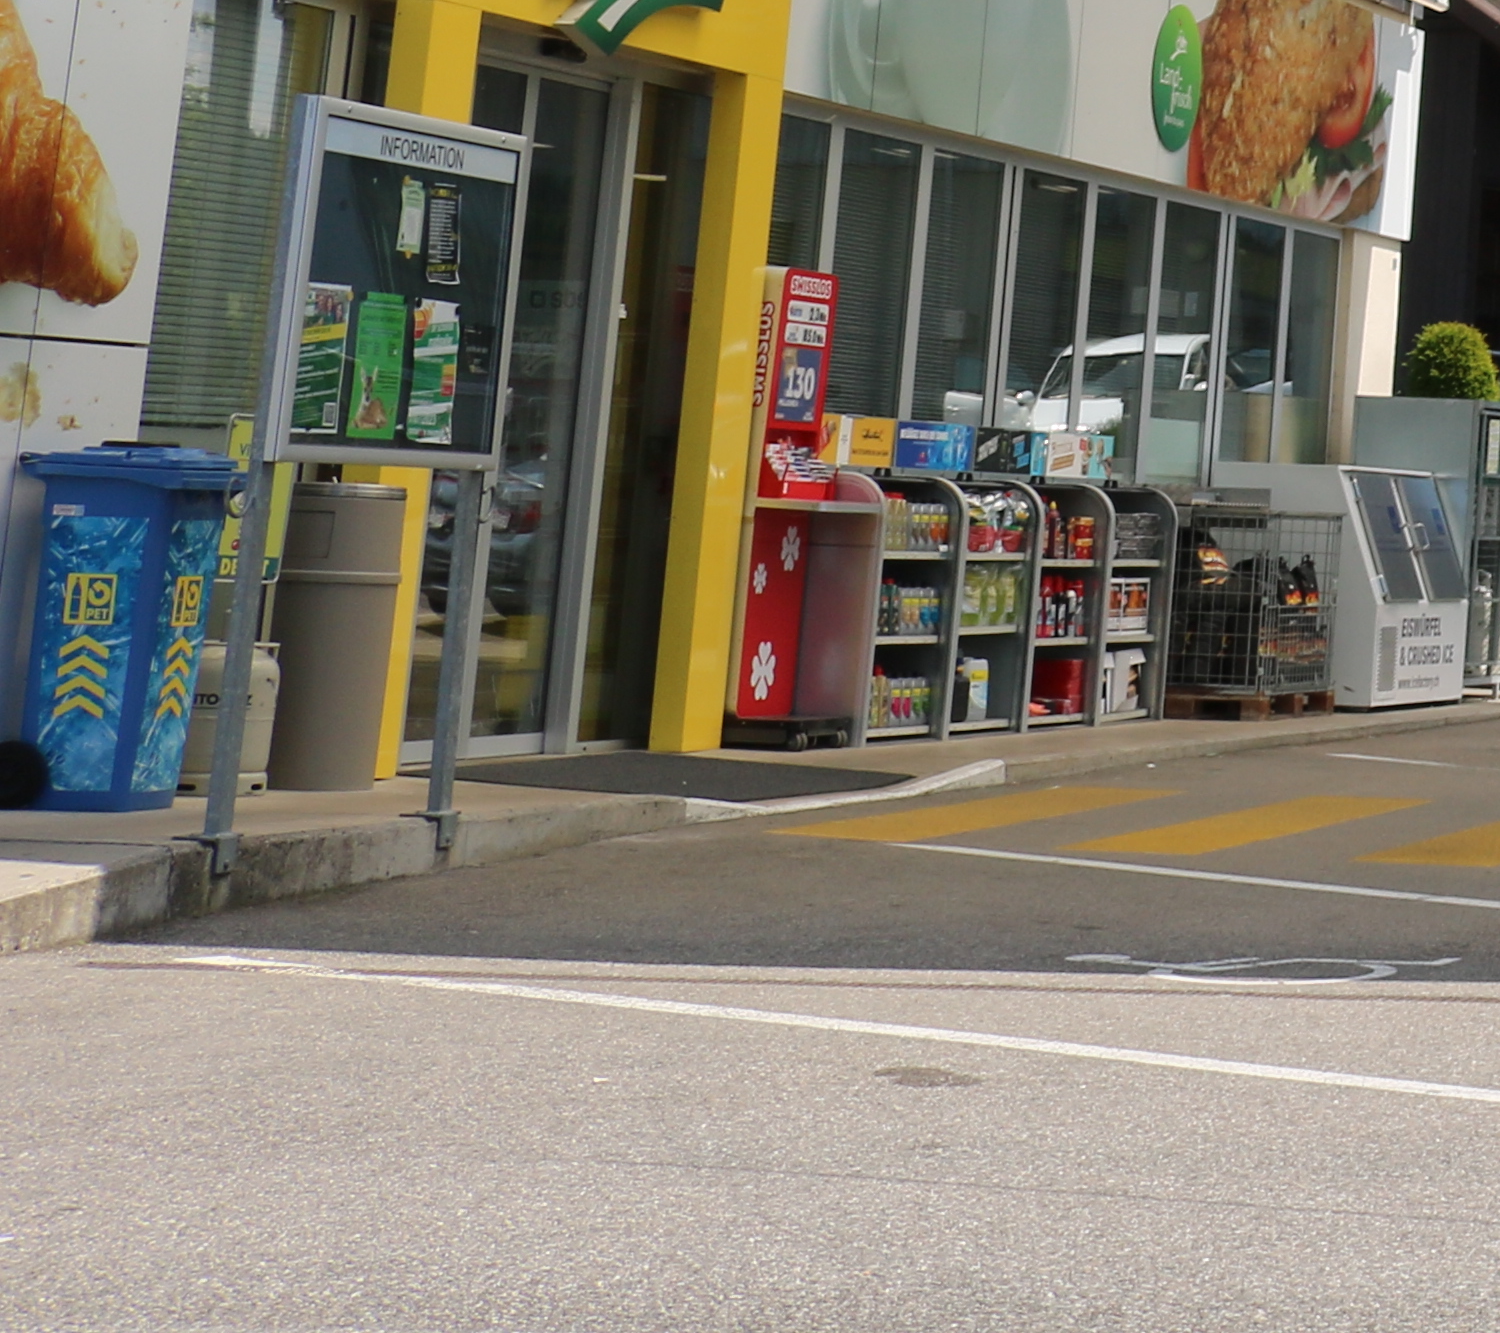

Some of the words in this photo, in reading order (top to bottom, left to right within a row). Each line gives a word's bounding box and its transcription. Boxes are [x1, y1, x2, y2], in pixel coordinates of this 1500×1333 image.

[380, 134, 466, 171] INFORMATION
[790, 275, 833, 299] SWISSLOS
[752, 301, 775, 408] SWISSLOS
[785, 366, 816, 400] 130
[86, 608, 110, 620] PET
[1401, 613, 1442, 638] EISWÜRFEL
[1408, 645, 1441, 666] CRUSHED
[1443, 644, 1454, 663] ICE
